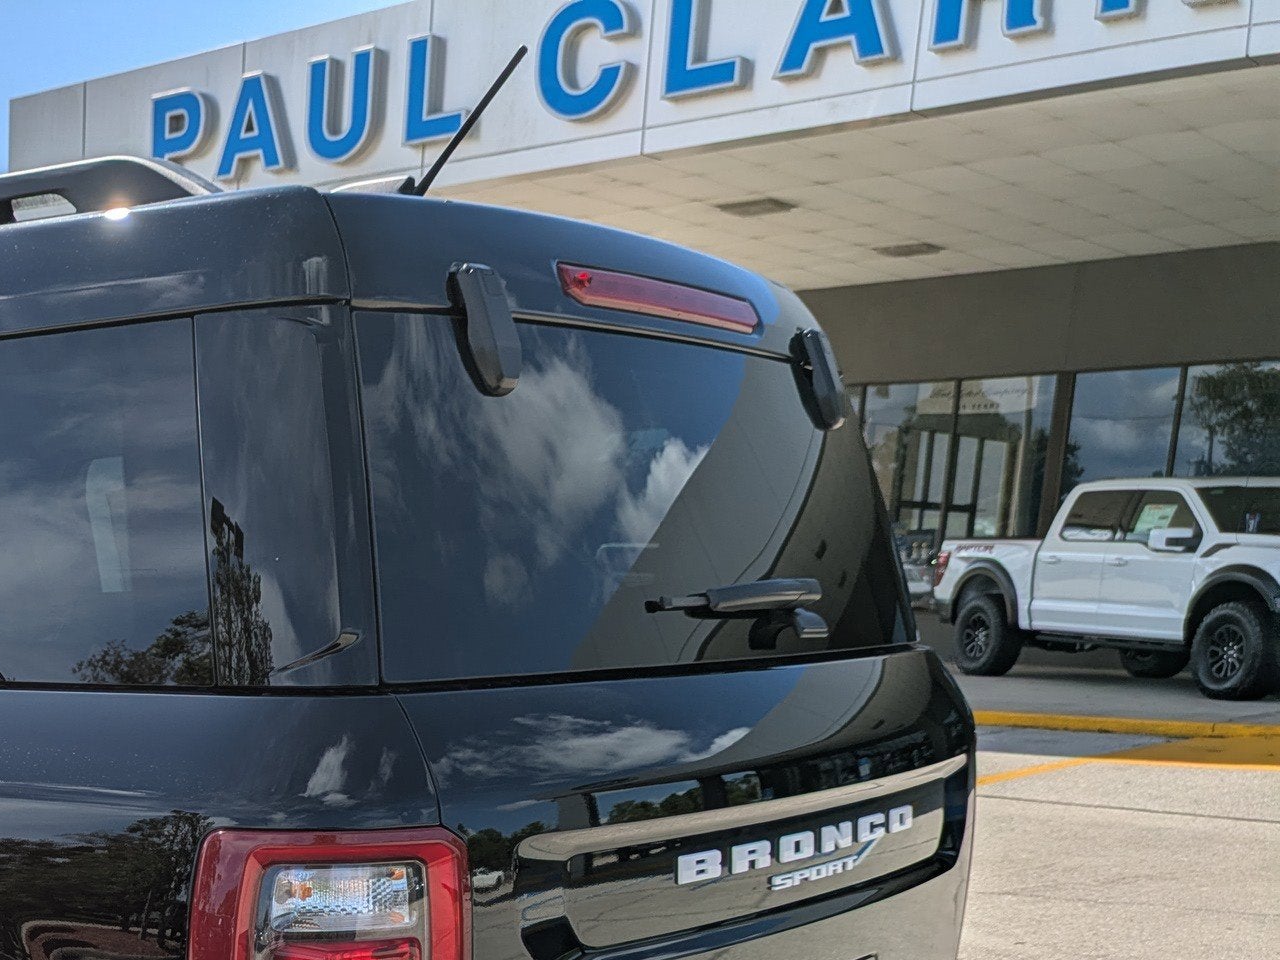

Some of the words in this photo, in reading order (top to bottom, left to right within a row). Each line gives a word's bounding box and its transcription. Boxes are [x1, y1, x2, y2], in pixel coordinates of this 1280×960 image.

[150, 33, 467, 184] PAUL
[676, 804, 914, 886] BRONCO
[769, 854, 860, 891] SPORT
